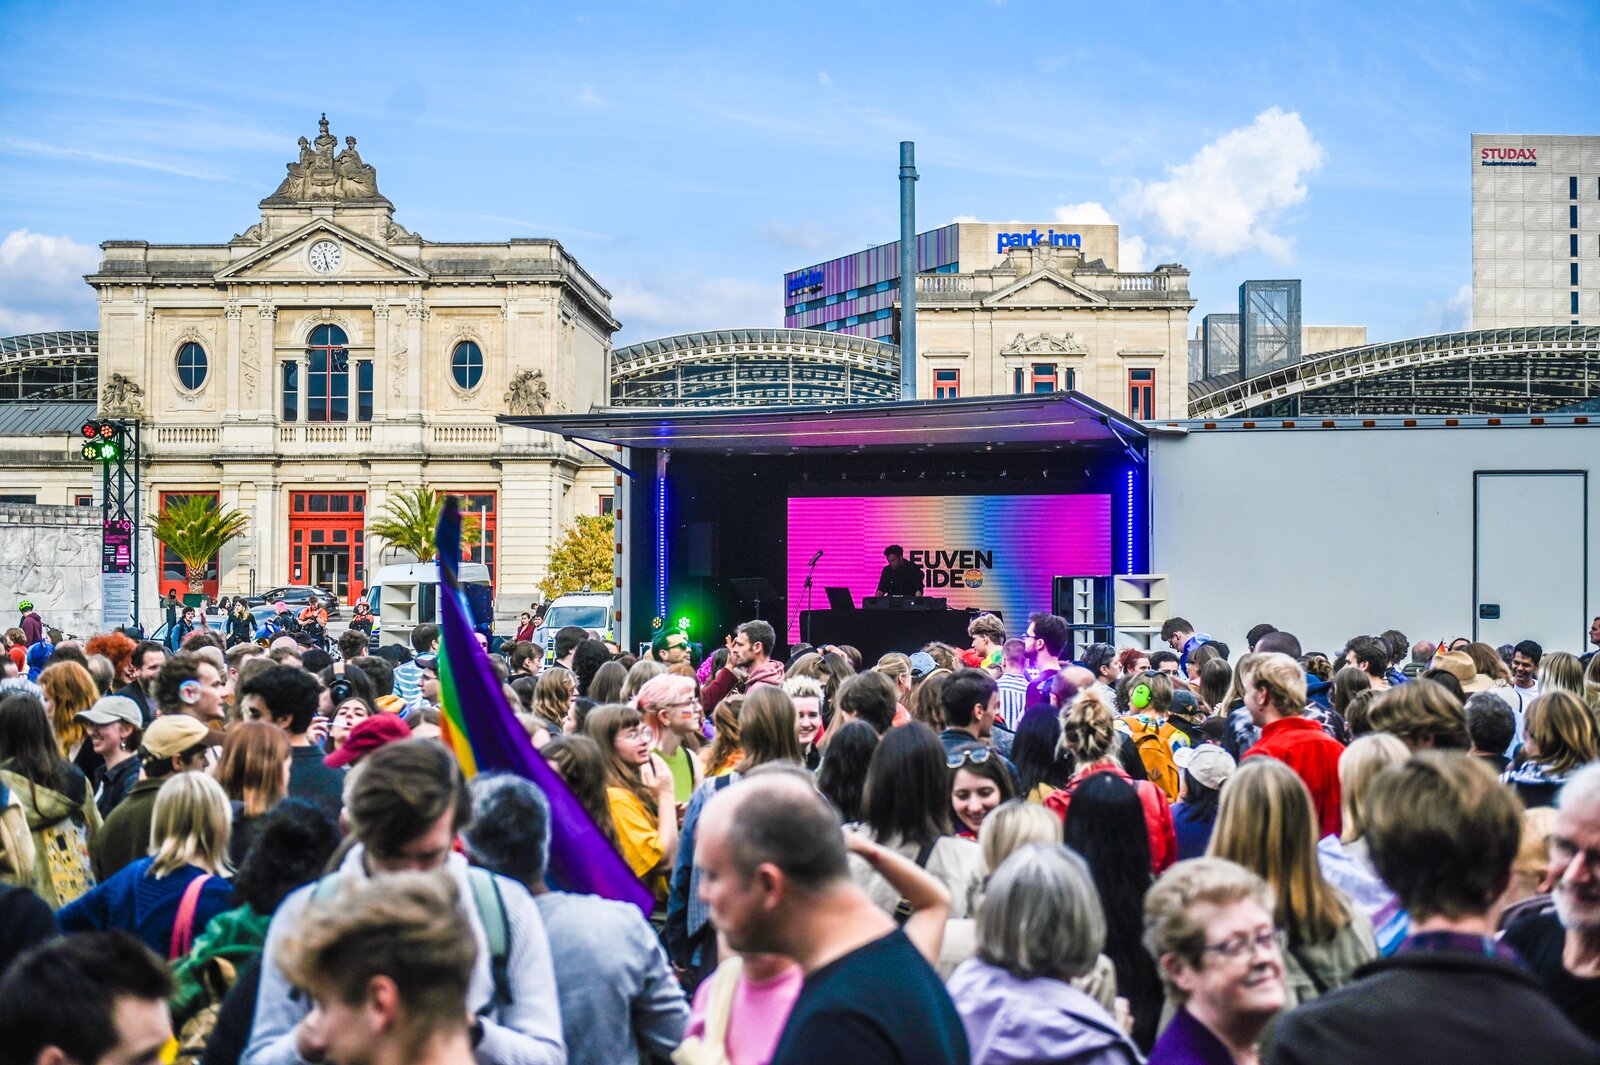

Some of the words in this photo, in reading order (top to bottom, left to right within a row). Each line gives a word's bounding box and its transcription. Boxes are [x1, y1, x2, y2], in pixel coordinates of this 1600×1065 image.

[1482, 148, 1536, 160] STUDAX
[997, 230, 1044, 254] park
[1048, 230, 1081, 248] inn
[910, 550, 993, 569] EUVEN
